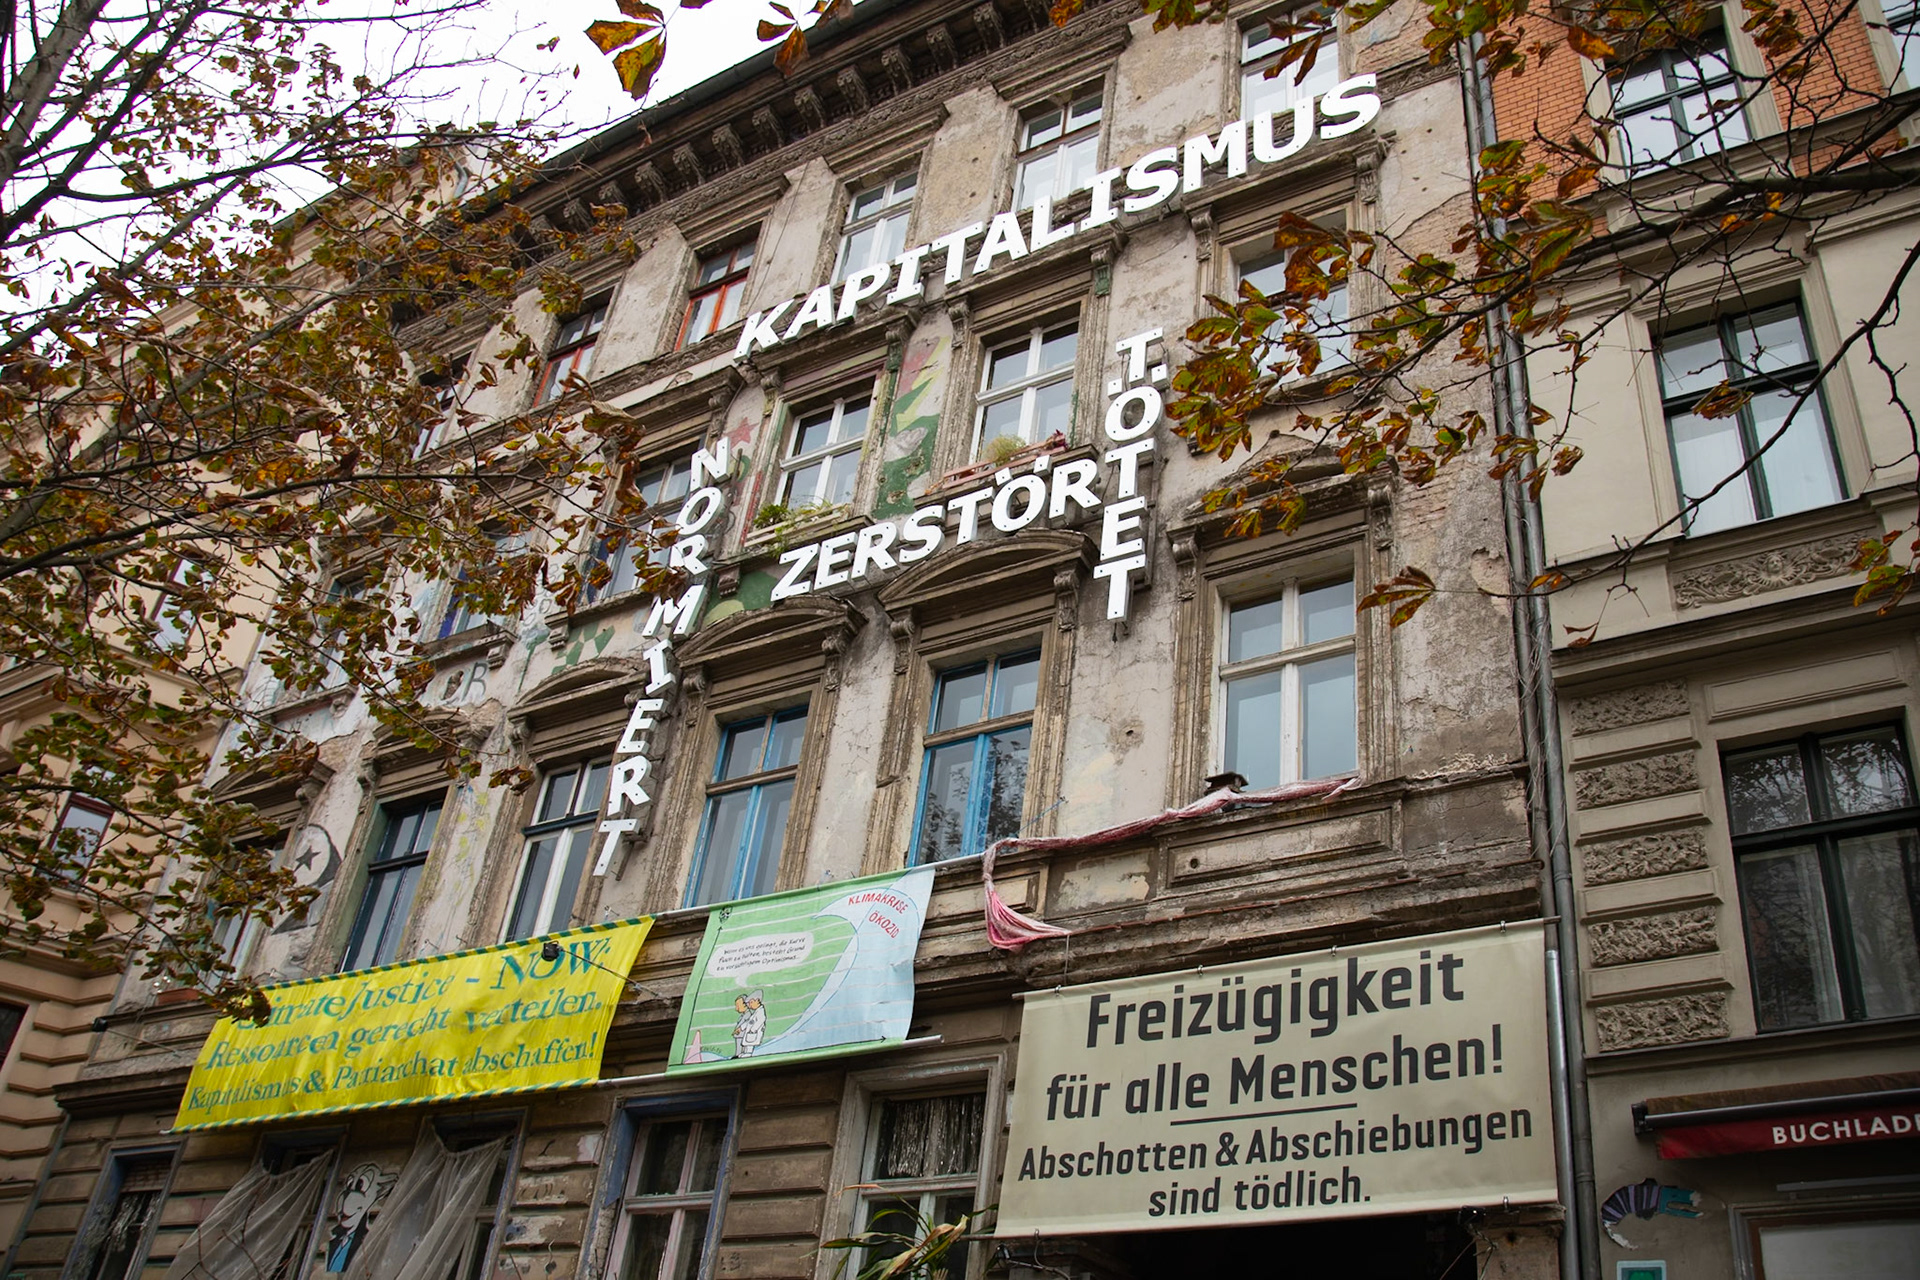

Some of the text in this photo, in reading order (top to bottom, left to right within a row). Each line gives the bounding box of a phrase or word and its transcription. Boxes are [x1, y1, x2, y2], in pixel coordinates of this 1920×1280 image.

[733, 73, 1382, 363] KAPITALISMUS
[1093, 328, 1169, 620] TÖTET
[593, 436, 730, 877] NORMIERT
[848, 892, 909, 914] KLIMAKRISE
[868, 909, 900, 938] ÖKOZID
[344, 1007, 452, 1058] gerecht
[465, 987, 602, 1034] verteilen.
[1086, 950, 1464, 1048] Freizügigkeit
[303, 1070, 325, 1094] &
[333, 1050, 459, 1089] Patriarchat
[462, 1031, 598, 1076] abschaffen!
[1046, 1024, 1502, 1121] für alle Menschen!
[1018, 1107, 1532, 1181] Abschotten & Abschiebungen
[1148, 1166, 1372, 1217] sind tödlich.
